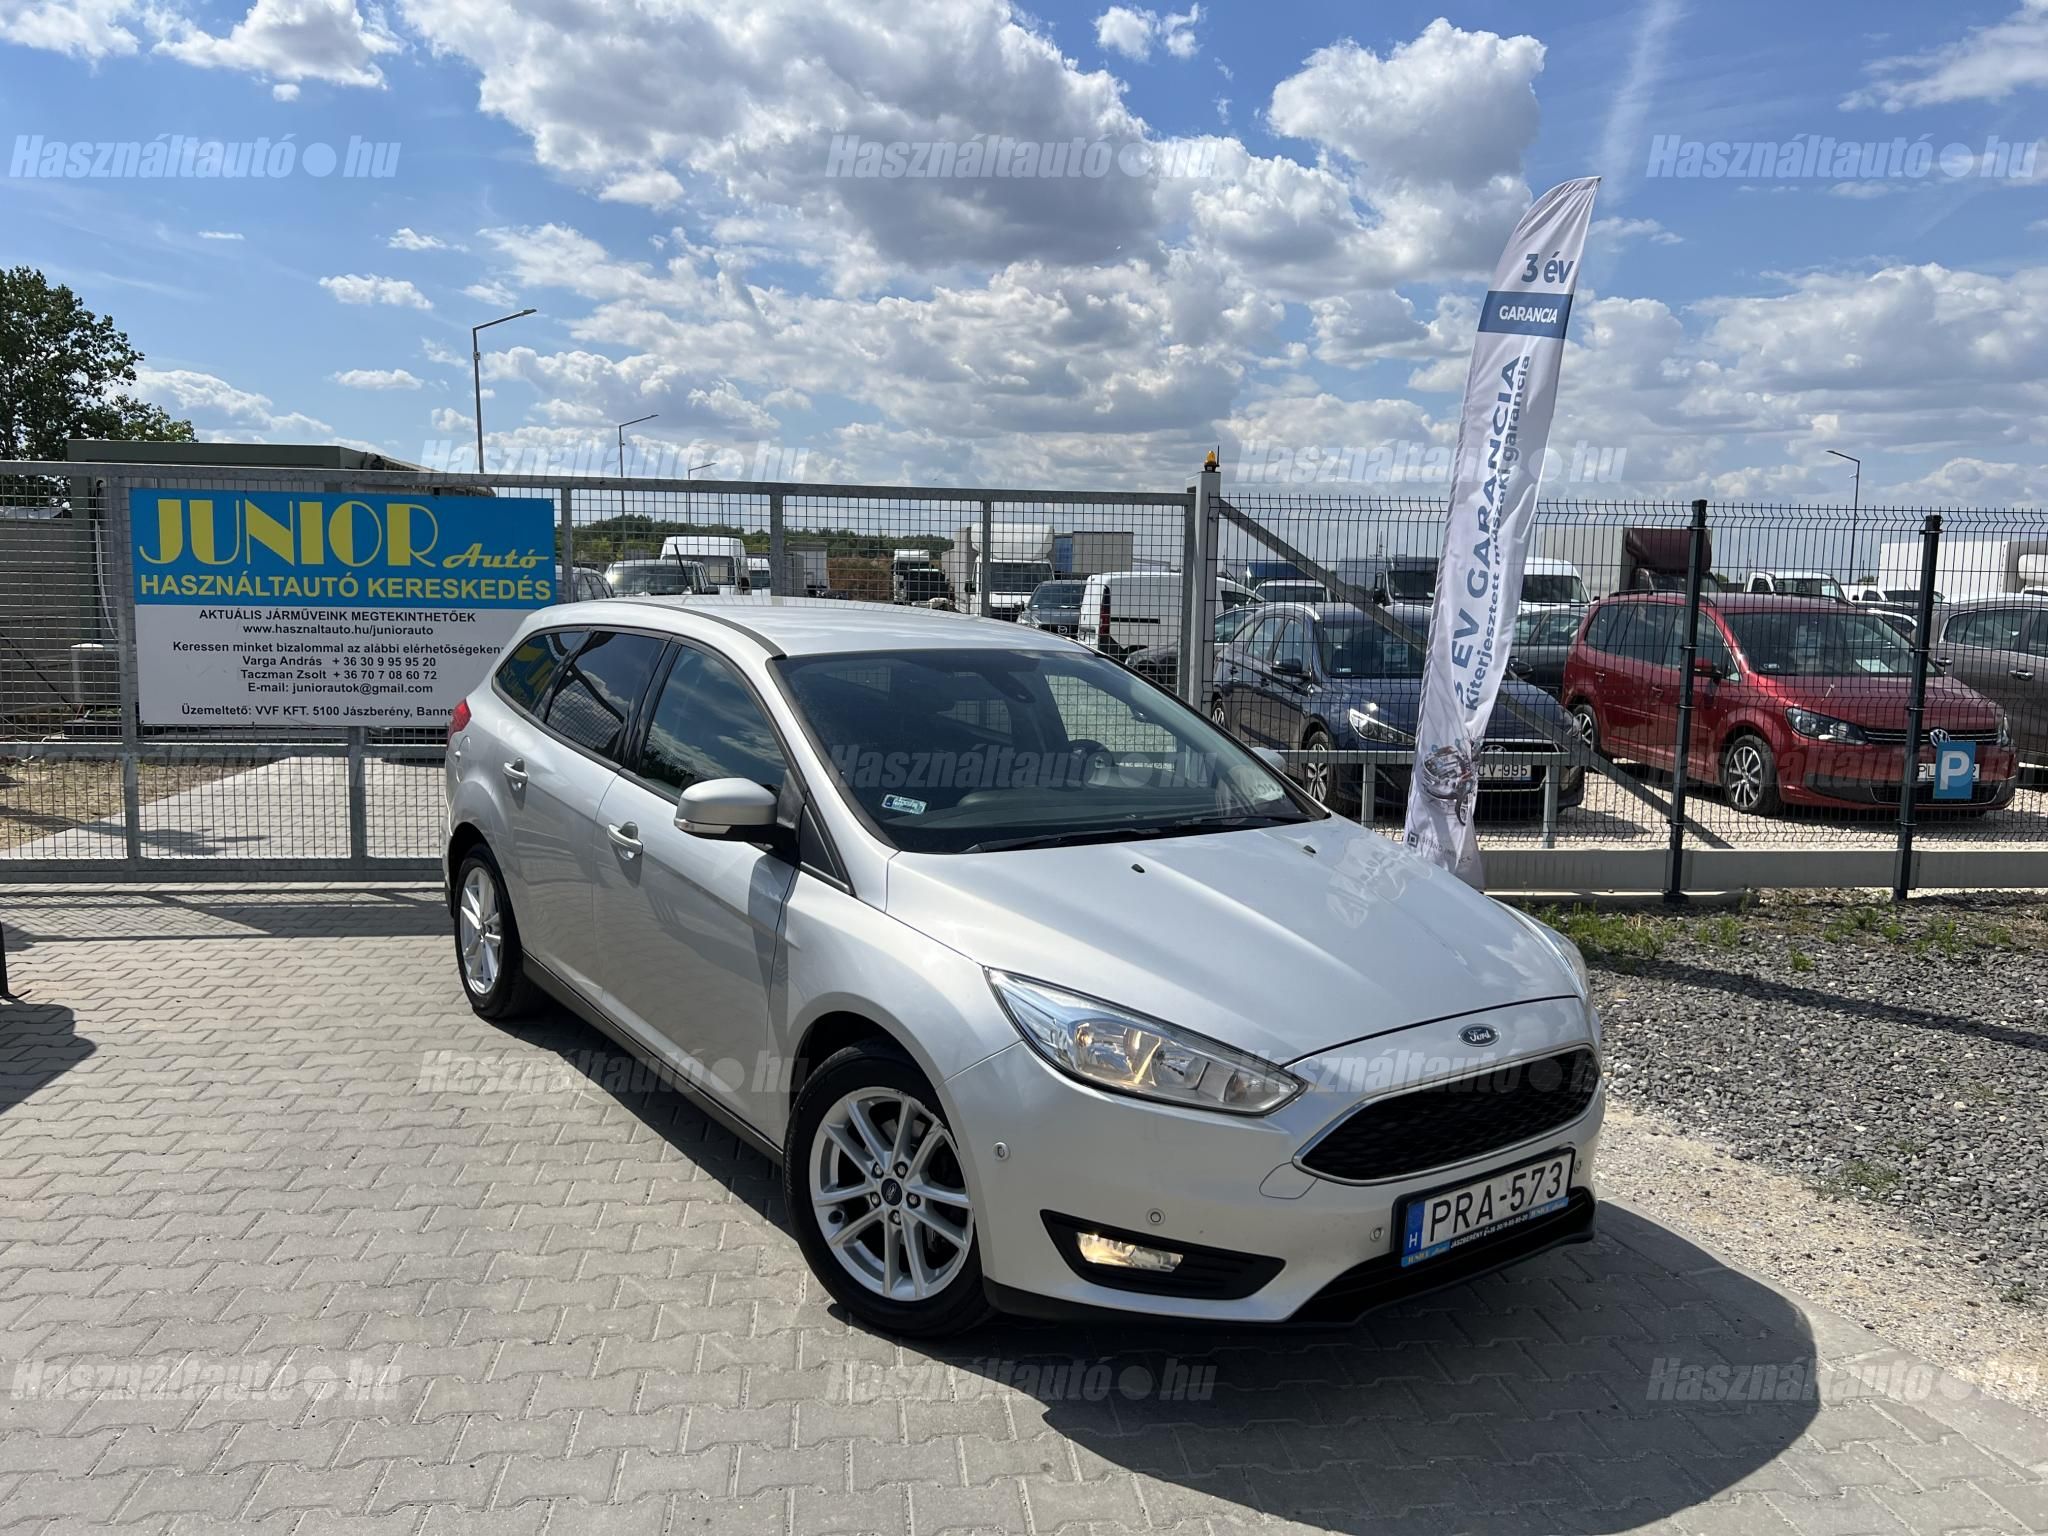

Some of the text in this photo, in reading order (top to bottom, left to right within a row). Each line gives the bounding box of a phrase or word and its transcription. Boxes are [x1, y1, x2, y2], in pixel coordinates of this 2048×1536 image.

[1521, 251, 1574, 284] 3 év
[1499, 305, 1559, 324] GARANCIA
[1467, 355, 1521, 599] GARANCIA
[139, 498, 549, 569] JUNIOR Autó
[1465, 571, 1500, 711] Kiterjesztett
[1502, 355, 1531, 462] garancia
[140, 570, 551, 600] HASZNÁLTAUTÓ KERESKEDÉS
[199, 607, 476, 622] AKTUÁLIS JÁRMŰVEINK MEGTEKINTHETŐEK
[243, 624, 434, 637] www.hasznaltauto.hu/juniorauto
[173, 641, 229, 651] Keressen
[232, 642, 273, 652] minket
[276, 643, 344, 653] bizalommal
[347, 645, 360, 653] az
[363, 644, 400, 653] alábbi
[242, 655, 437, 667] Varga András + 36 30 9 95 95 20
[240, 669, 293, 679] Taczman
[296, 669, 327, 679] Zsolt
[344, 670, 358, 679] 36
[361, 670, 375, 679] 70
[378, 670, 385, 679] 7
[388, 670, 402, 679] 08
[406, 670, 420, 680] 60
[423, 670, 437, 679] 72
[248, 682, 433, 695] E-mail: juniorautok@gmail.com
[181, 702, 252, 715] Üzemeltető:
[255, 706, 280, 716] VVF
[283, 705, 309, 716] KFT.
[312, 706, 340, 716] 5100
[343, 706, 413, 719] Jászberény,
[1477, 764, 1528, 777] CV-995
[1939, 750, 1970, 790] P
[1468, 1029, 1492, 1043] Ford
[1408, 1160, 1563, 1248] H PRA-573
